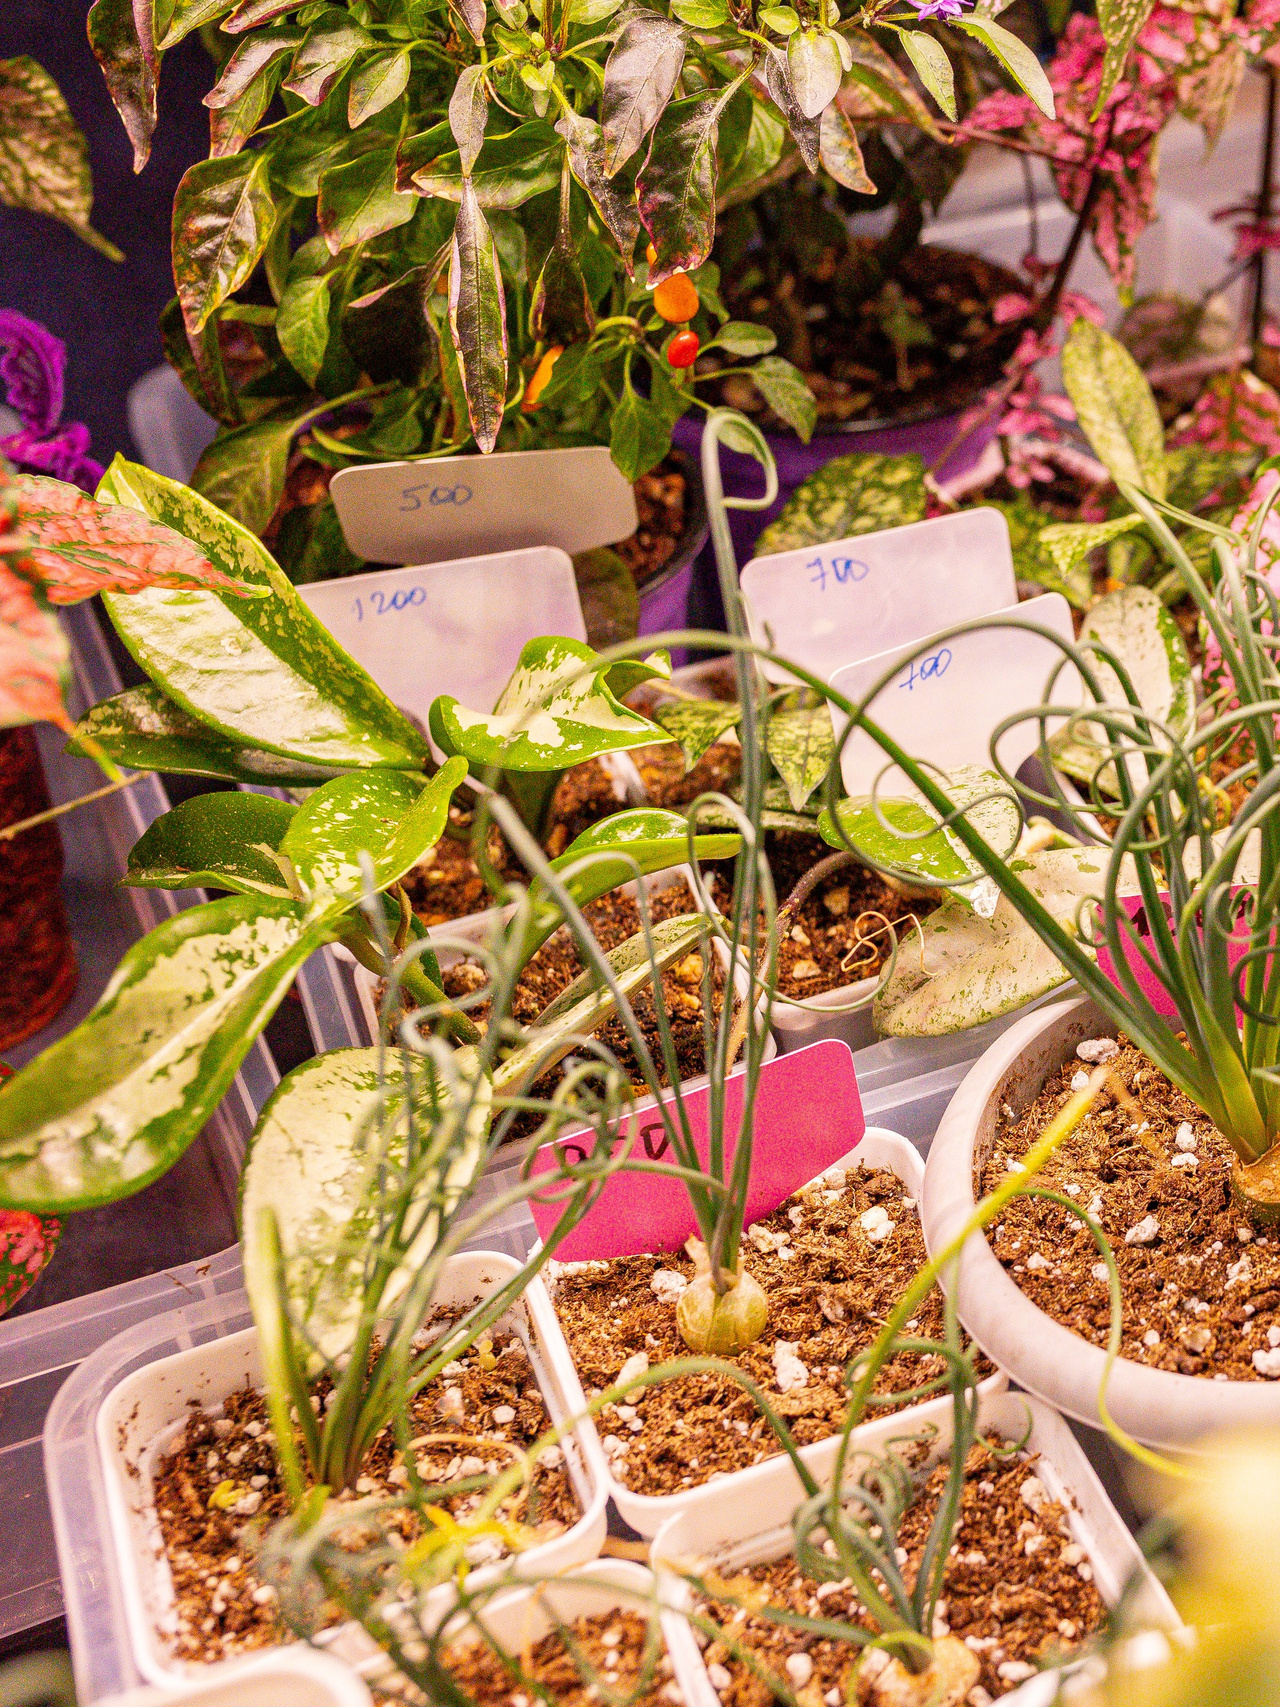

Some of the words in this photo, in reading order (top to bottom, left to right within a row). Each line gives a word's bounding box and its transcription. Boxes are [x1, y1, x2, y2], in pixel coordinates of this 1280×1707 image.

[399, 483, 474, 512] 500
[805, 556, 870, 592] 700
[353, 585, 428, 622] 1200
